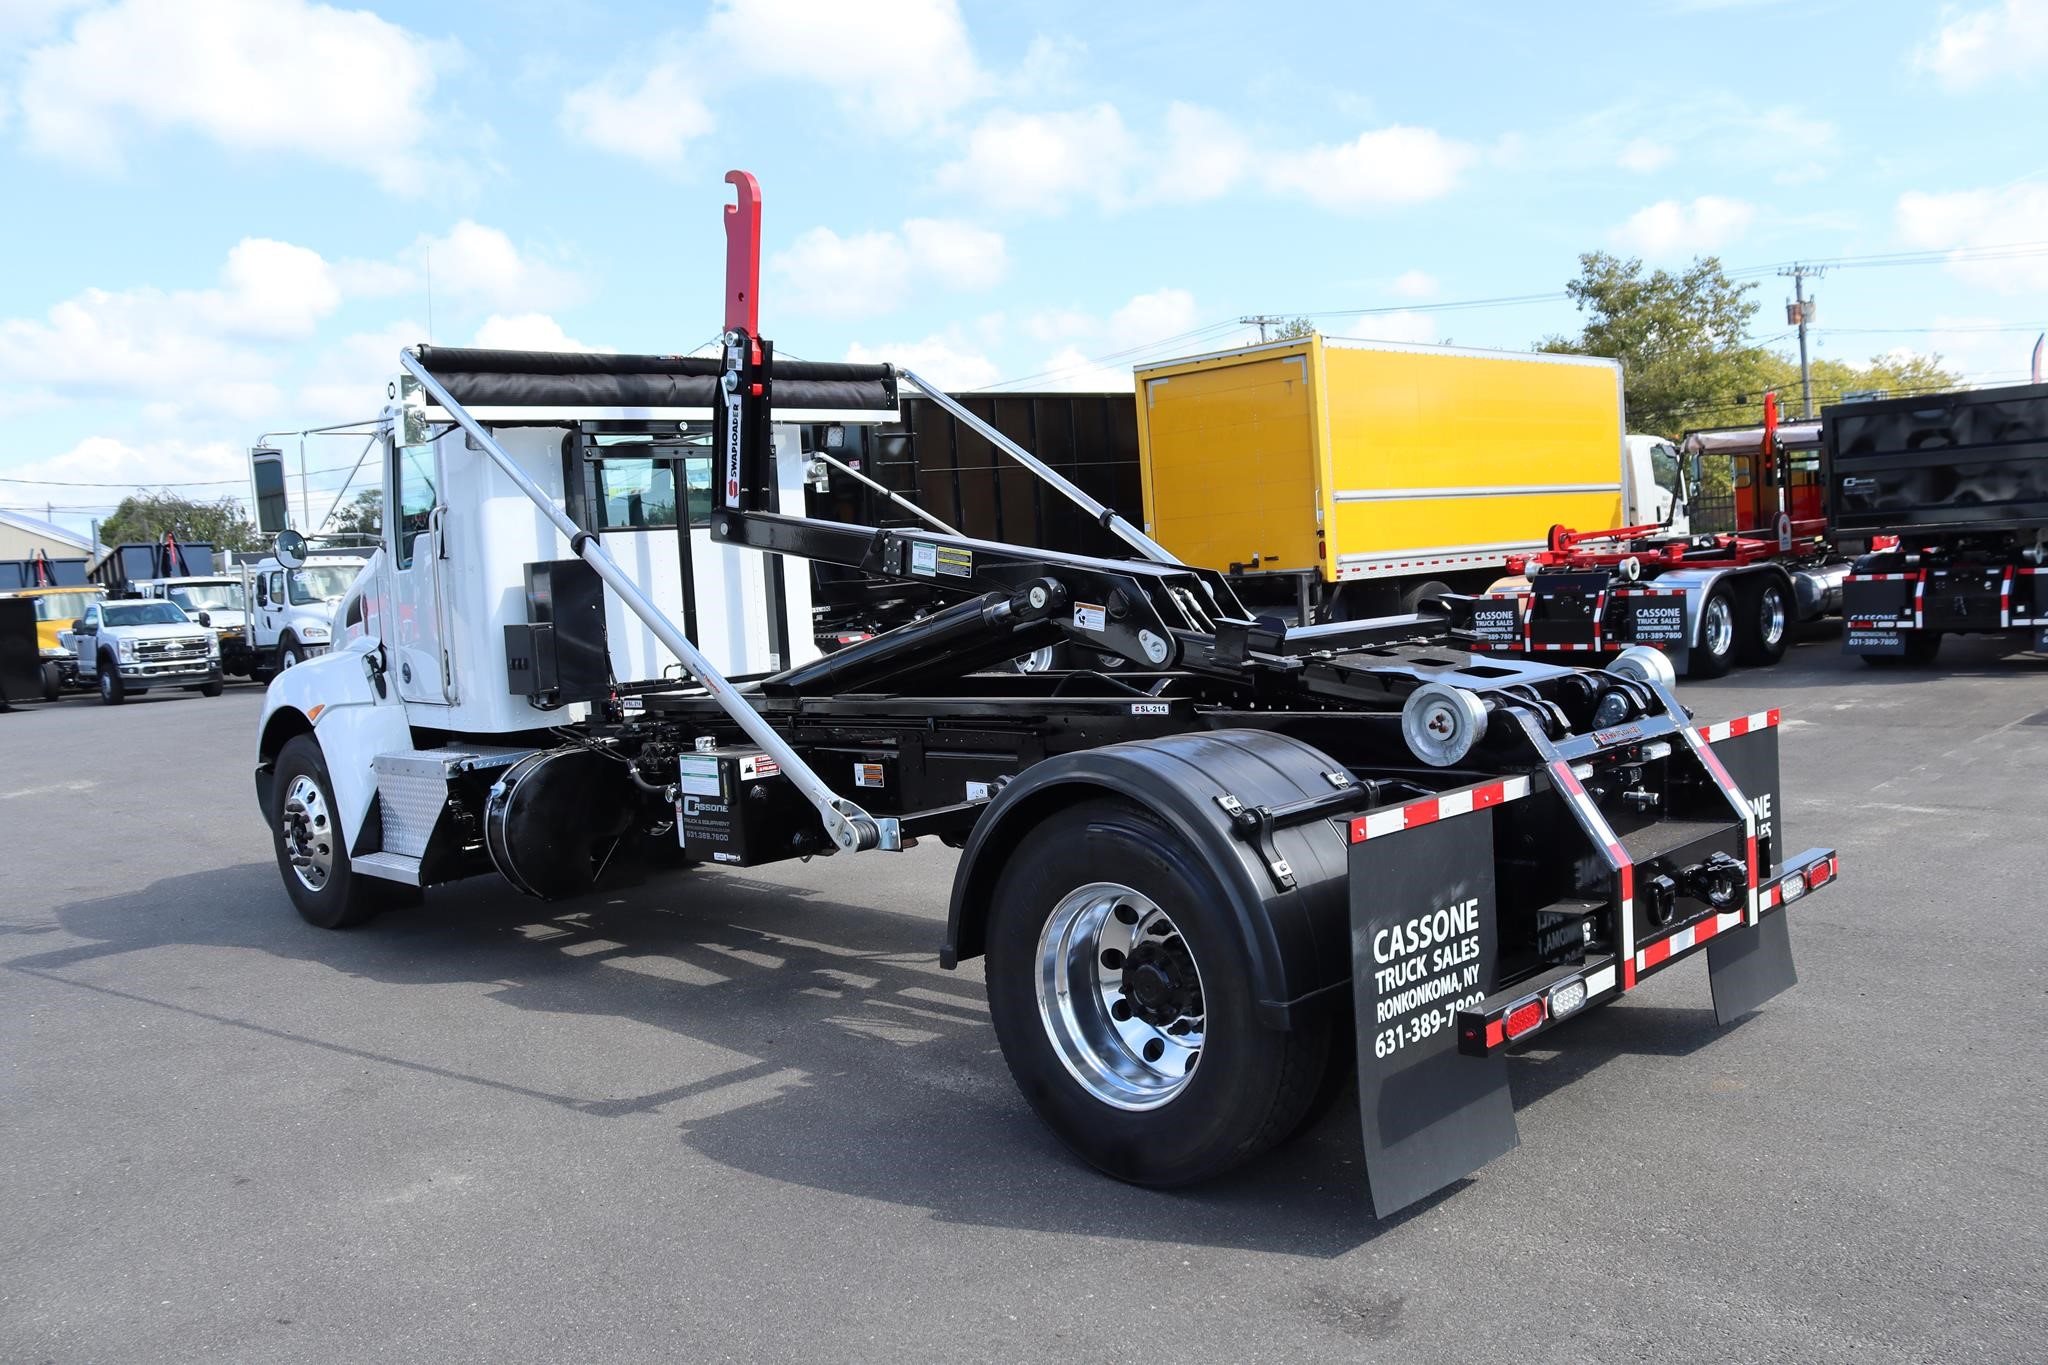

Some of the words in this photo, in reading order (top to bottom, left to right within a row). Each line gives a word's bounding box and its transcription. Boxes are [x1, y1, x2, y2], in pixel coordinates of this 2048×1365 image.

[730, 403, 740, 478] SWAPLOADER
[1475, 611, 1513, 620] CASSONE
[1636, 608, 1680, 618] CASSONE
[1140, 705, 1166, 713] SL-214
[683, 795, 729, 816] CASSONE
[1373, 898, 1479, 964] CASSONE
[1374, 954, 1428, 995] TRUCK
[1433, 935, 1480, 972] SALES
[1377, 972, 1463, 1024] RONKONKOMA,
[1463, 963, 1480, 987] NY
